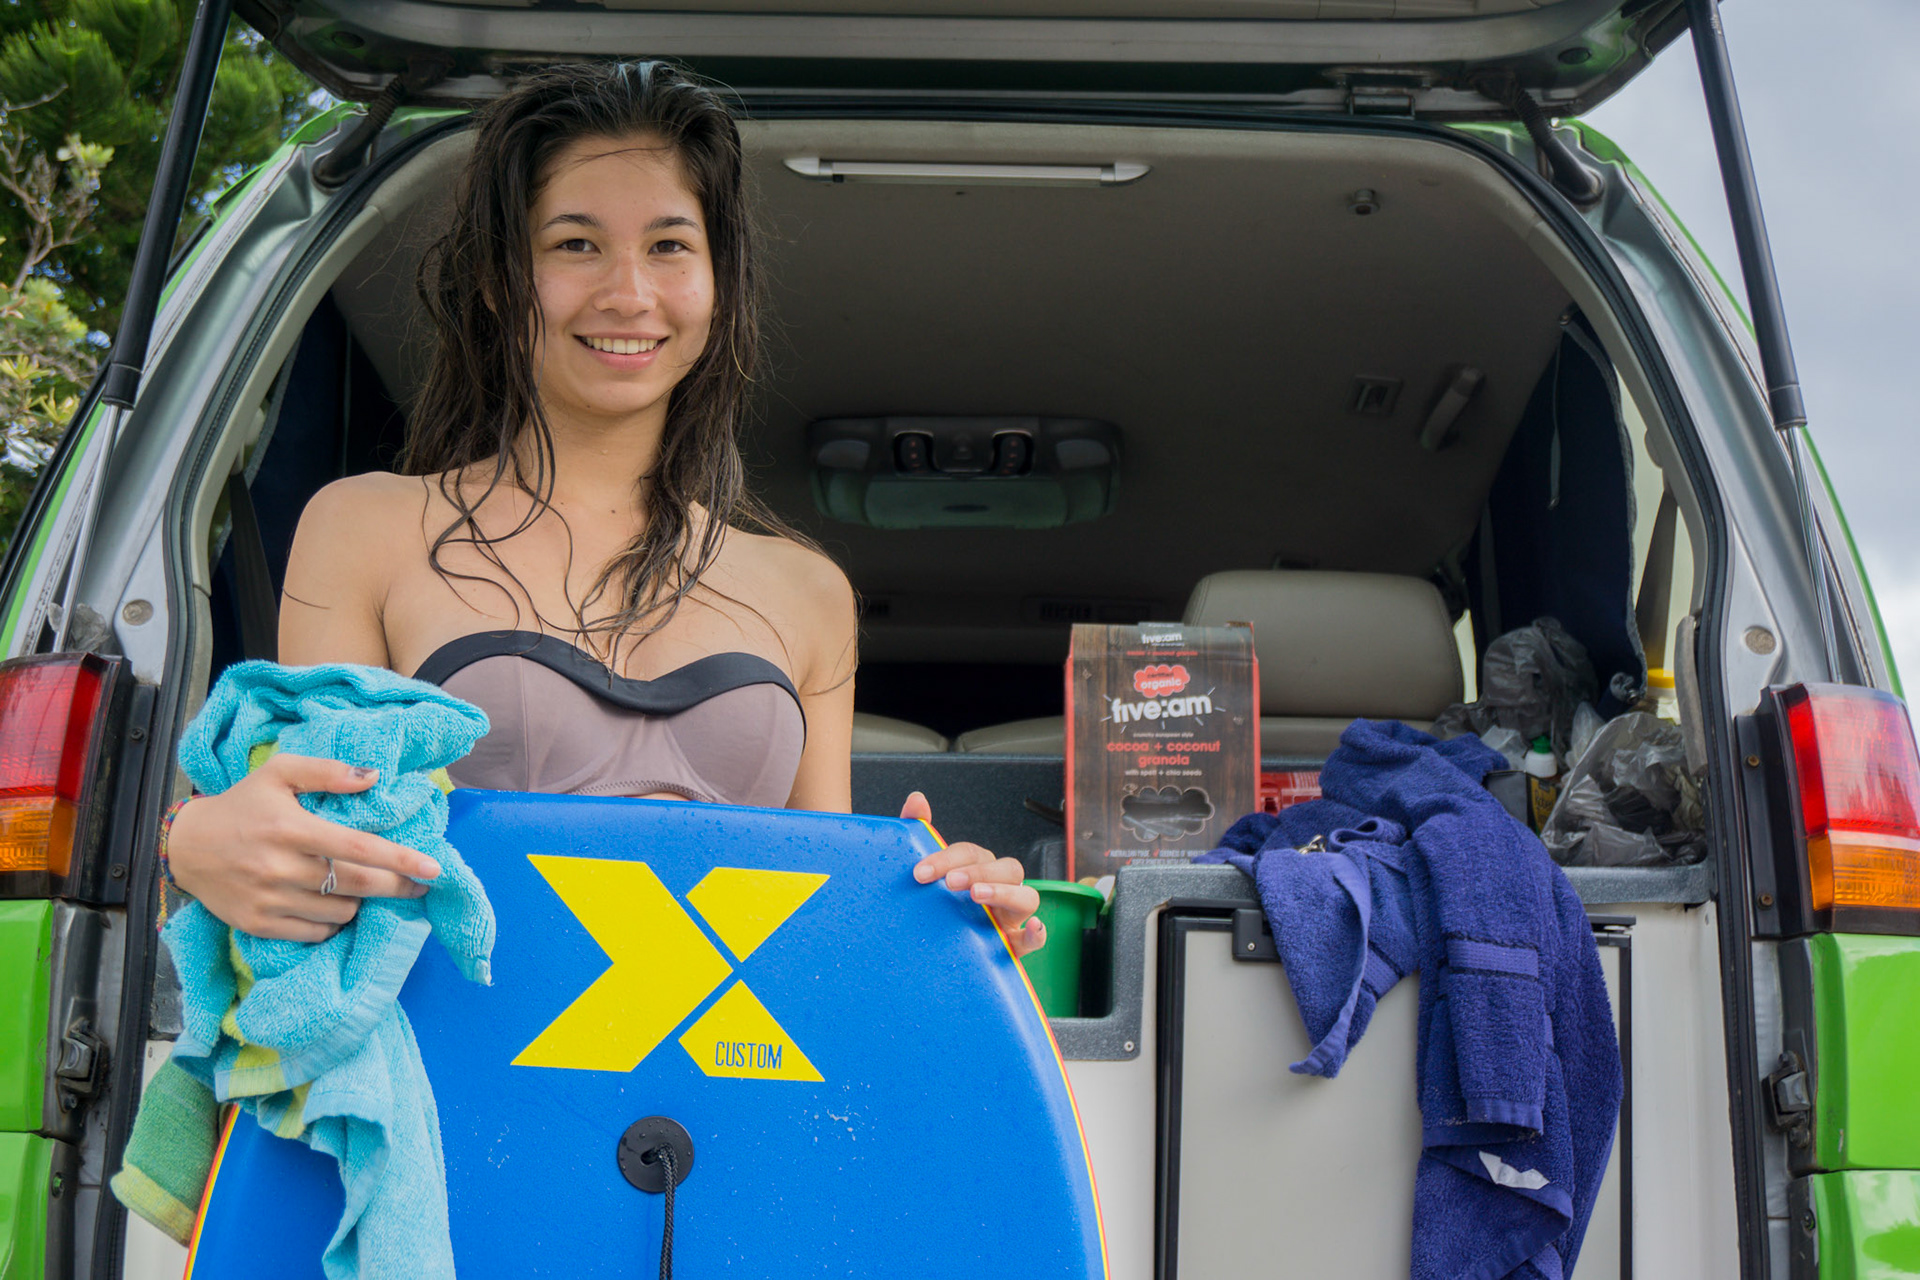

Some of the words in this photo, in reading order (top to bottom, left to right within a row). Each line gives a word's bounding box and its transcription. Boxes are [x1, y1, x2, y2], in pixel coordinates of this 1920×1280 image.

[1141, 633, 1182, 644] five:am
[1140, 677, 1182, 690] organic
[1111, 695, 1213, 723] five:am
[1106, 742, 1150, 752] cocoa
[1166, 740, 1221, 752] coconut
[1138, 754, 1190, 768] granola
[715, 1041, 782, 1069] CUSTOM
